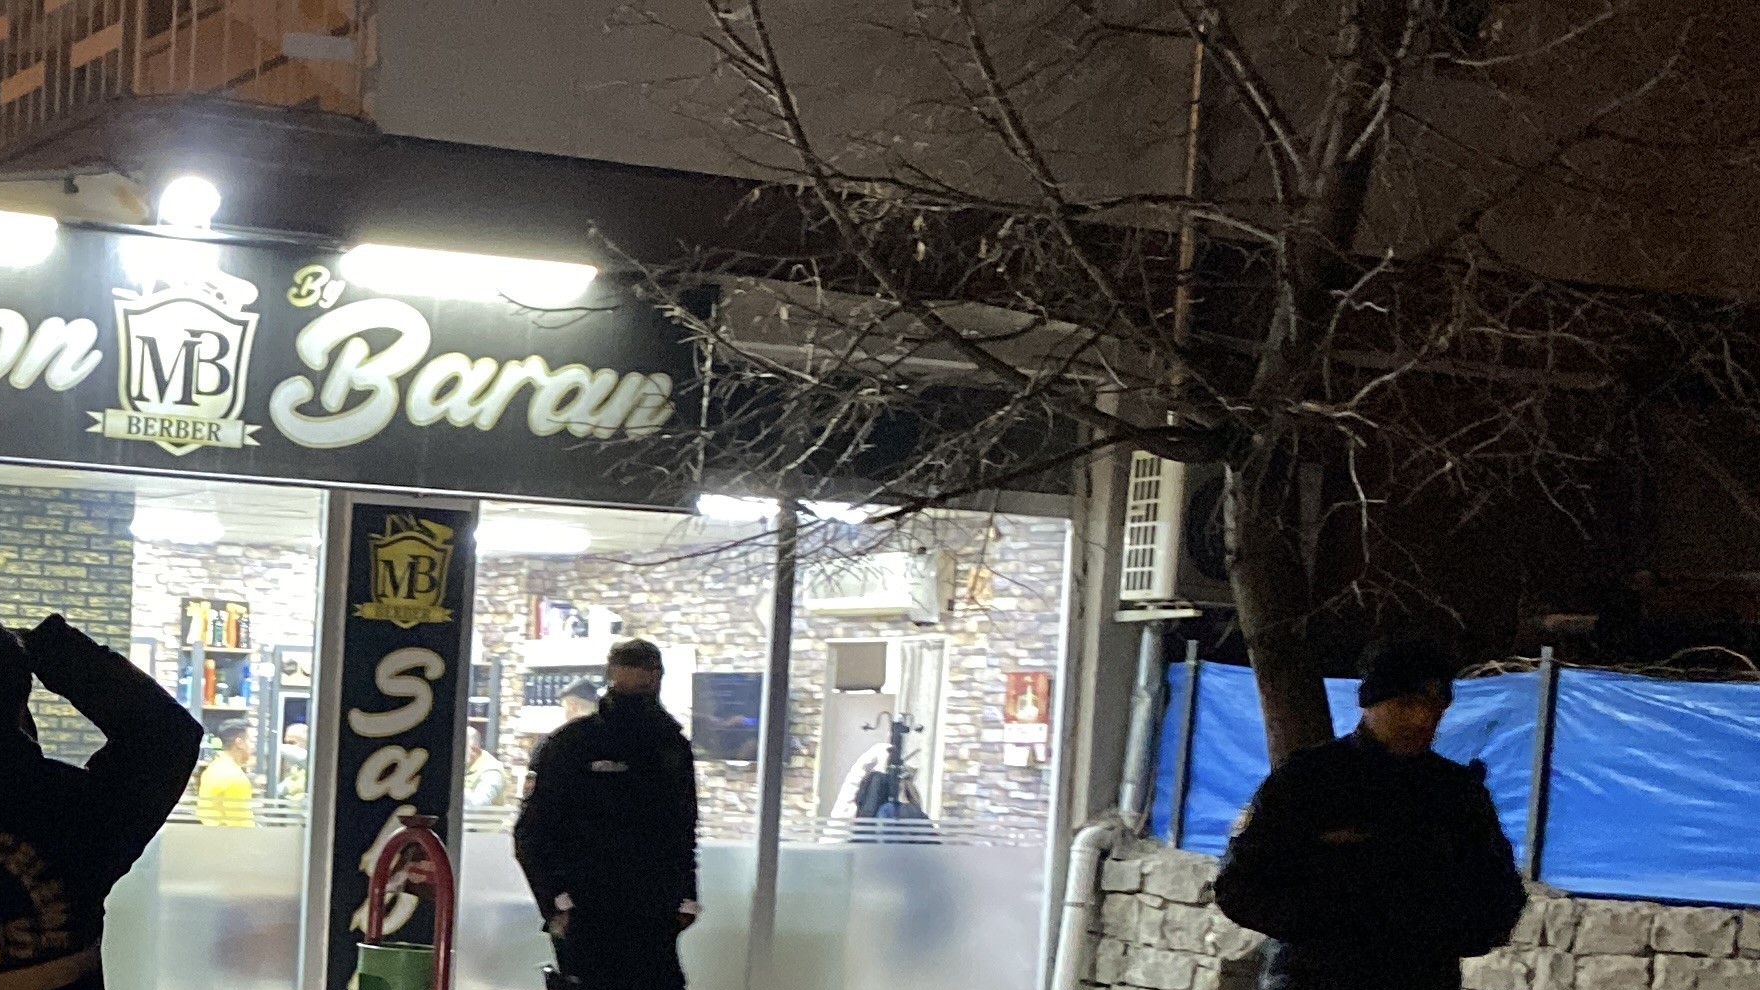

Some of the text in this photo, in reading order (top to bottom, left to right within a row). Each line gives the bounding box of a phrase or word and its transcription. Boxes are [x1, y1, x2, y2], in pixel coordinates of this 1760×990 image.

[287, 265, 345, 309] By
[134, 327, 232, 410] MB
[269, 297, 674, 449] Baran
[127, 415, 222, 443] BERBER
[379, 552, 439, 600] MB
